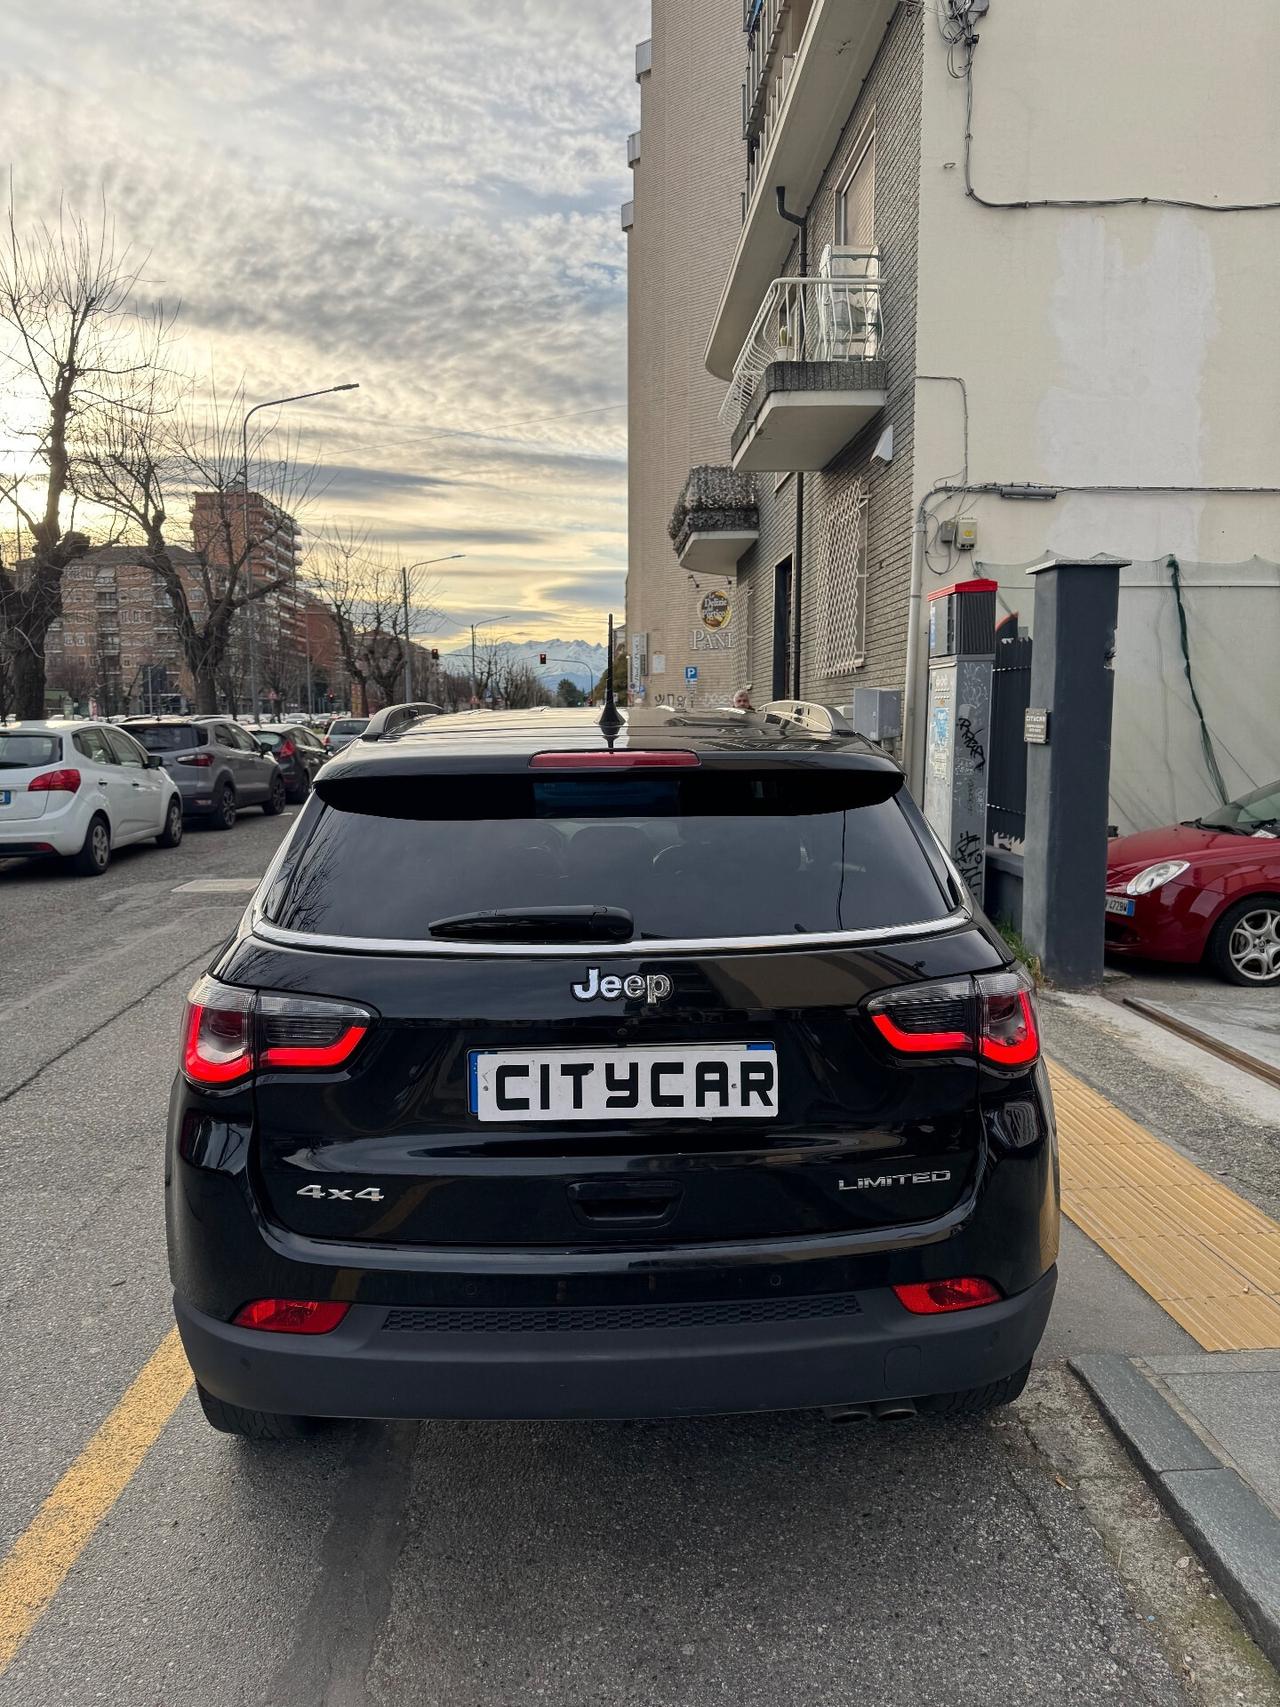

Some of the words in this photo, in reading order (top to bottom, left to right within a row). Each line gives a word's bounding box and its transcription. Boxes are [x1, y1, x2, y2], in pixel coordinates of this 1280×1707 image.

[687, 668, 696, 678] P
[572, 967, 673, 1005] Jeep
[495, 1061, 774, 1111] CITYCAR
[296, 1184, 385, 1202] 4x4
